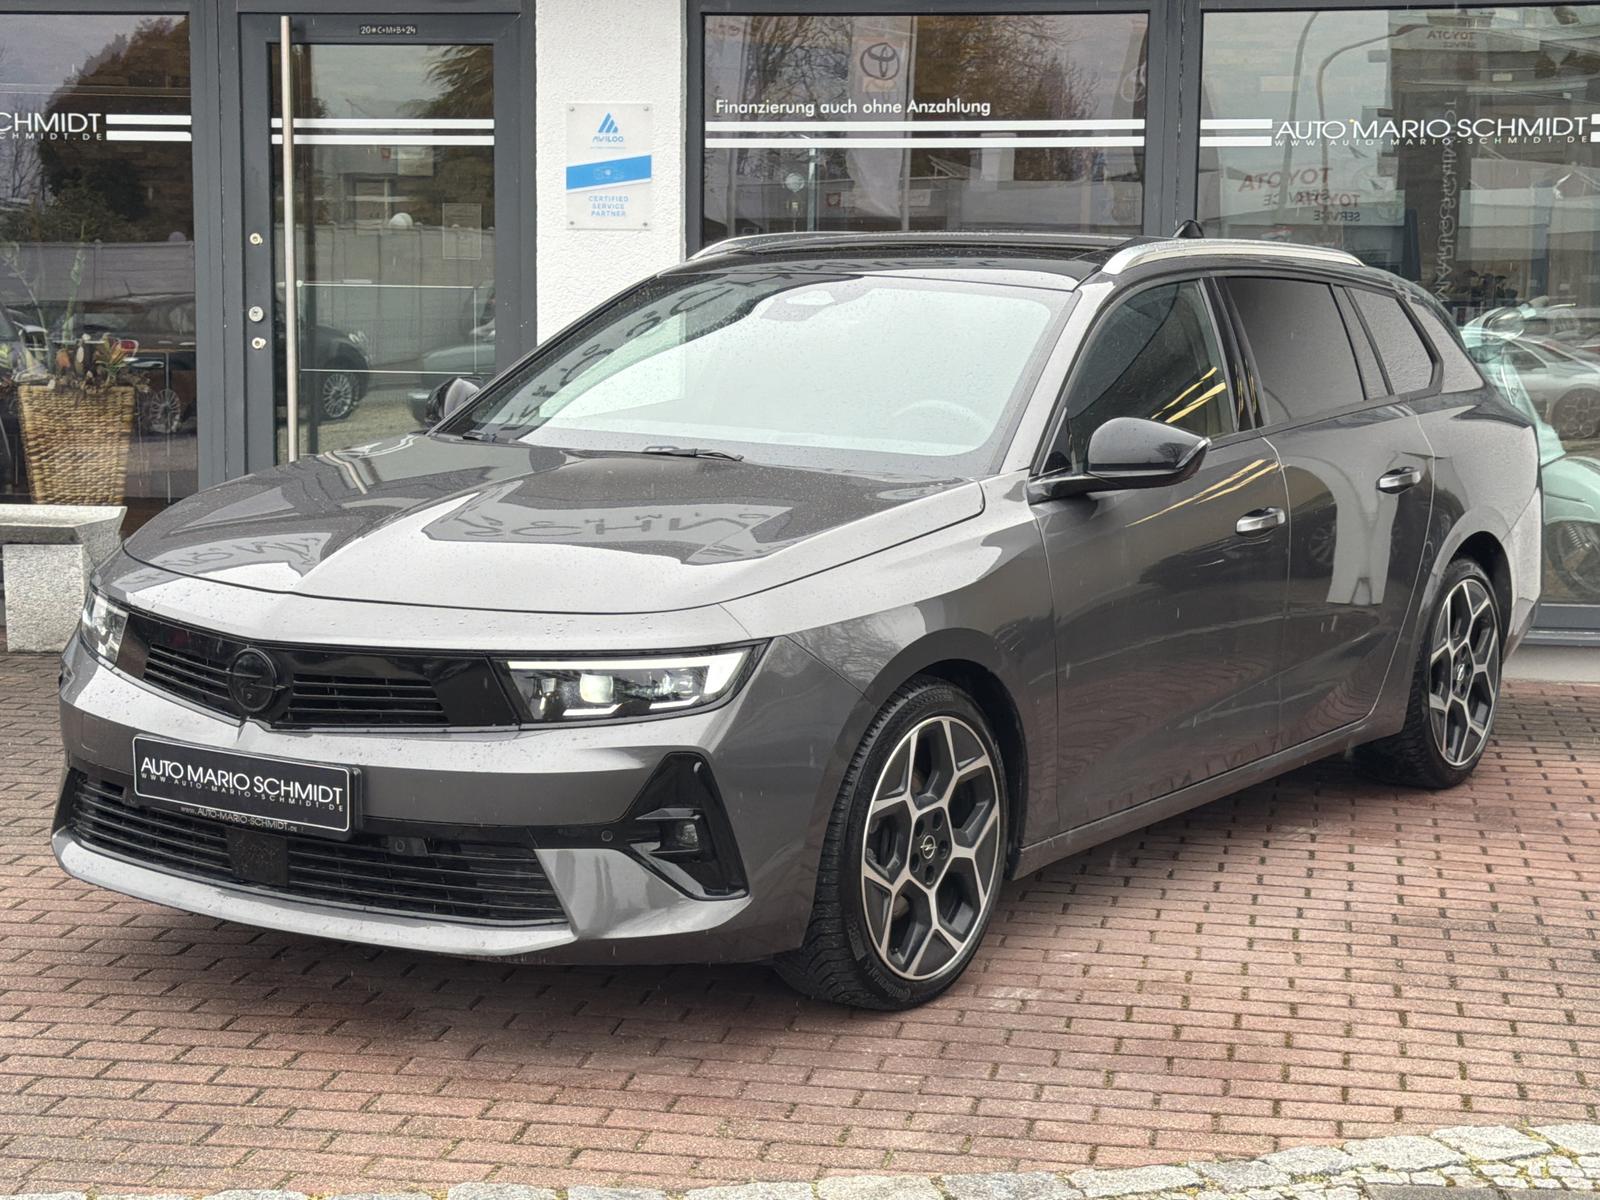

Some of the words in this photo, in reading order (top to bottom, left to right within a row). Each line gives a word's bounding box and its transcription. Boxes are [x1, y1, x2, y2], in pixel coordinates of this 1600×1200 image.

[715, 99, 815, 117] Finanzierung
[820, 98, 858, 114] auch
[862, 98, 902, 114] ohne
[907, 98, 991, 116] Anzahlung
[1275, 120, 1346, 139] AUTO
[1353, 119, 1452, 138] MARIO
[1456, 116, 1588, 137] SCHMIDT
[141, 756, 184, 779] AUTO
[187, 764, 250, 791] MARIO
[253, 776, 343, 805] SCHMIDT
